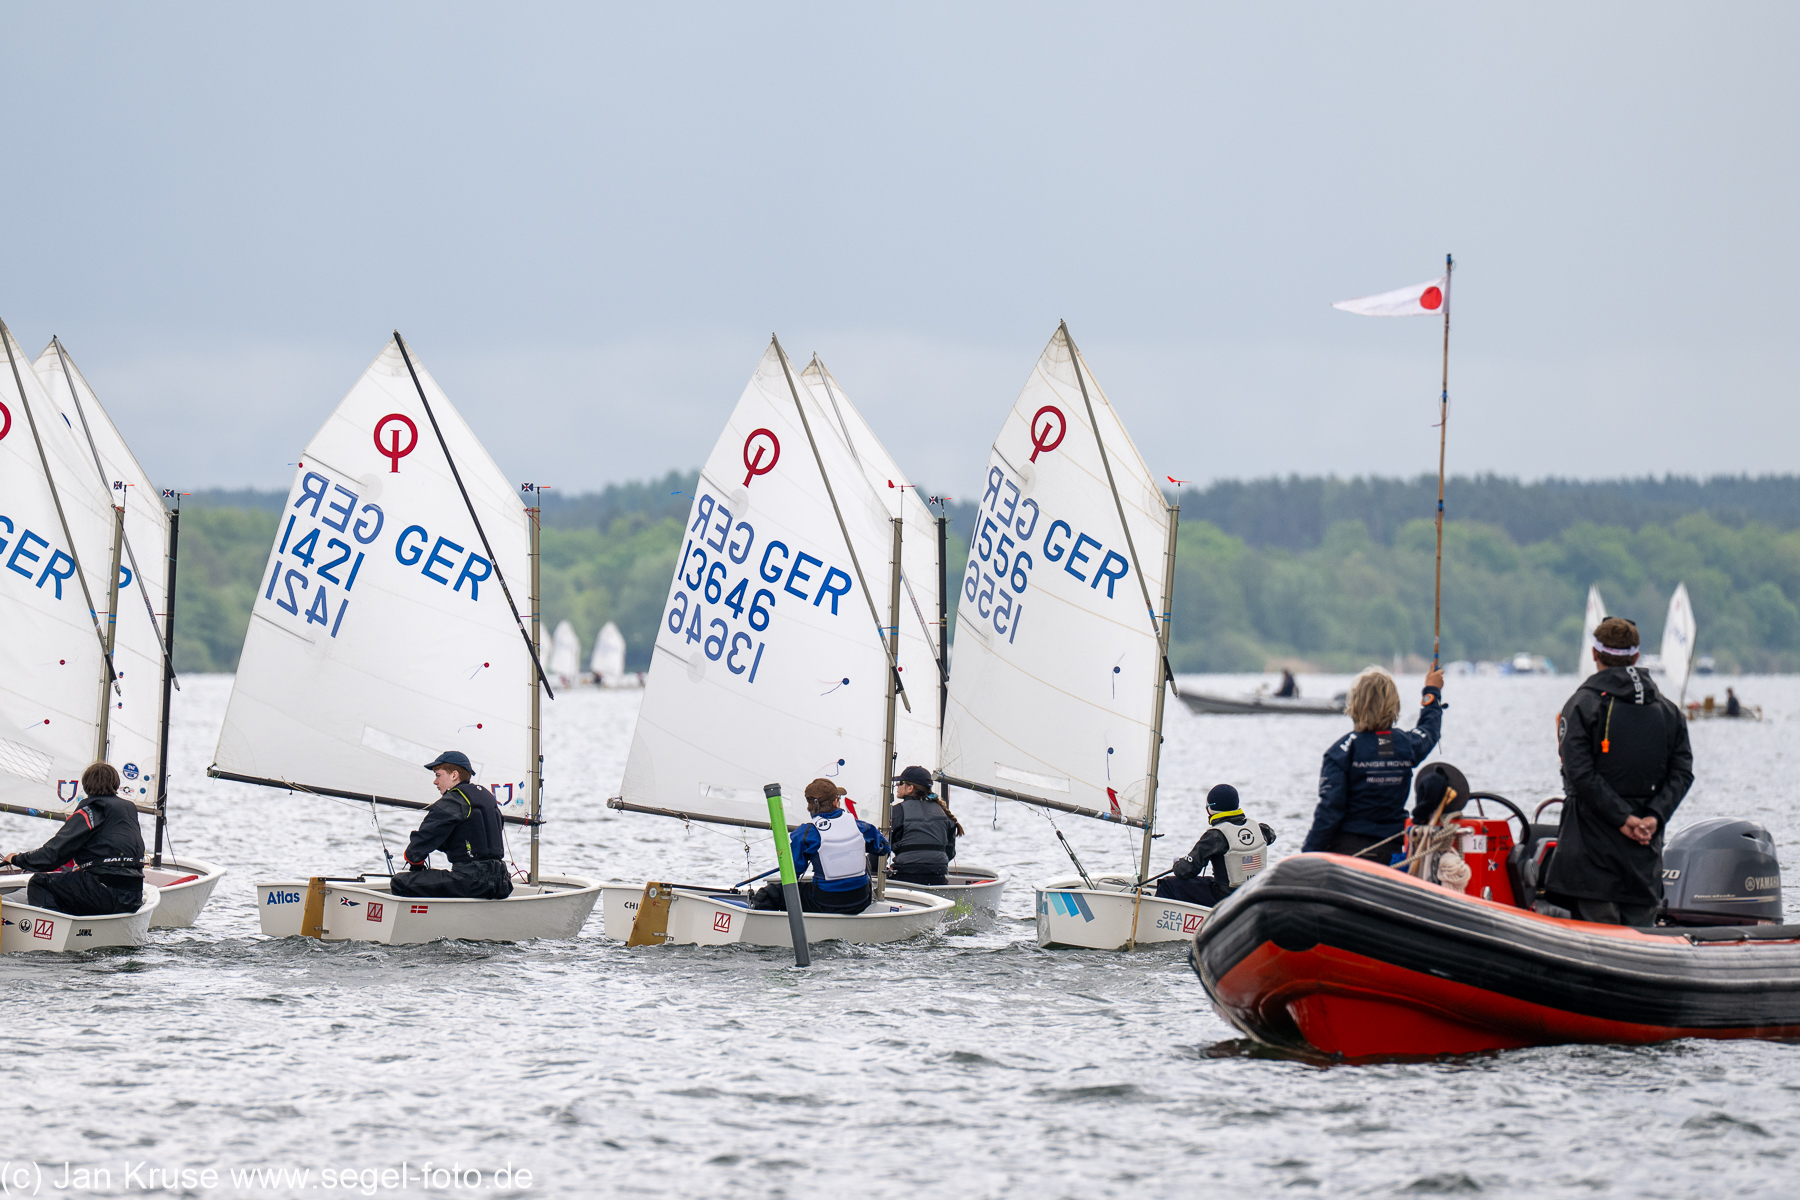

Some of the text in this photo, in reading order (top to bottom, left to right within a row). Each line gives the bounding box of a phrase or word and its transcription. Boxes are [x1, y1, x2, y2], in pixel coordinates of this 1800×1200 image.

[279, 514, 365, 592] 1421
[395, 524, 493, 602] GER
[972, 509, 1033, 594] 1556
[1043, 519, 1129, 599] GER
[678, 539, 776, 632] 13646
[759, 540, 853, 617] GER
[1352, 760, 1412, 769] RANGE ROVE
[266, 890, 301, 905] Atlas
[624, 901, 639, 910] CHI
[1755, 875, 1780, 890] YAMAHA
[1155, 919, 1183, 932] SALT
[1162, 909, 1183, 922] SEA
